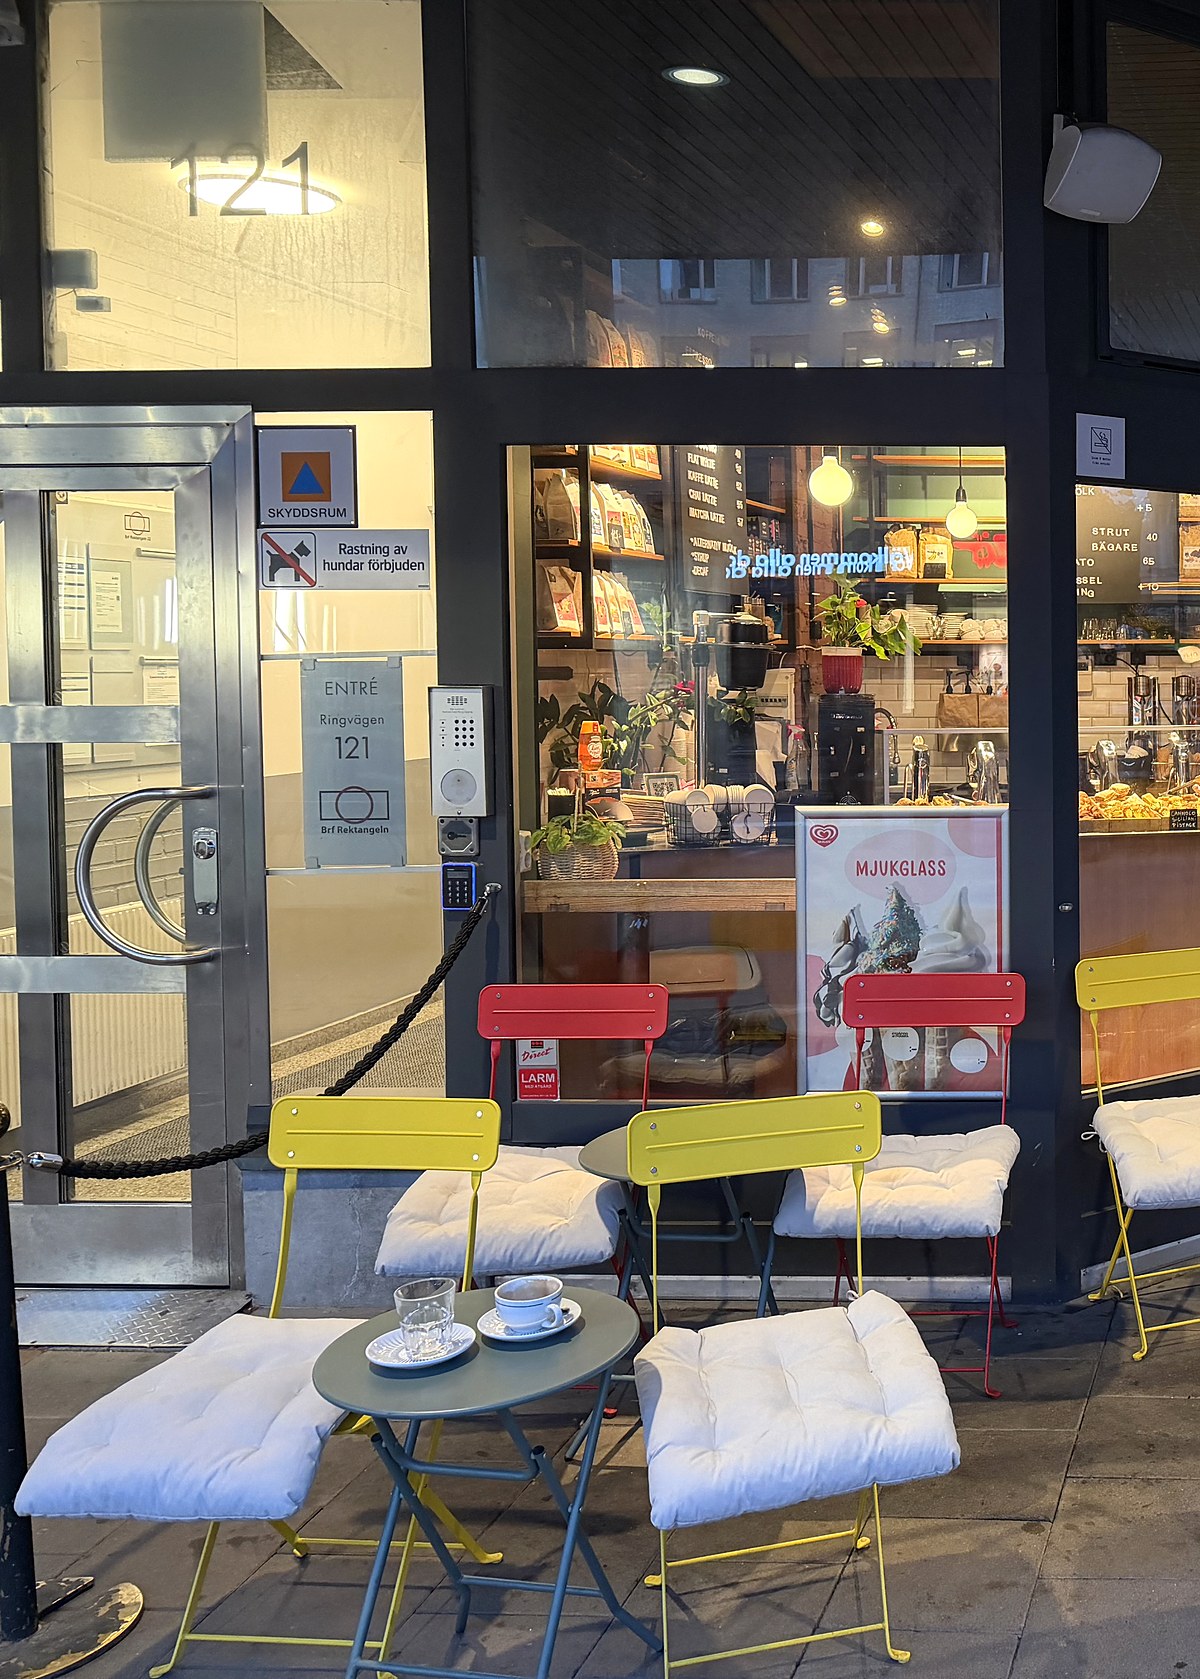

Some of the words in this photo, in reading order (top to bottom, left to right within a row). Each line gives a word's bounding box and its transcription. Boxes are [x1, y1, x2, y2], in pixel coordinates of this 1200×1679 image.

[170, 141, 310, 217] 121
[267, 507, 347, 518] SKYDDSRUM
[1091, 527, 1130, 537] STRUT
[1146, 532, 1158, 541] 40
[338, 542, 390, 557] Rastning
[393, 545, 408, 555] av
[1091, 540, 1138, 552] BÄGARE
[322, 559, 365, 571] hundar
[367, 559, 425, 574] förbjuden
[1142, 556, 1155, 566] 65
[325, 677, 379, 696] ENTRÉ
[319, 714, 385, 728] Ringvägen
[334, 736, 369, 759] 121
[321, 825, 336, 834] Brf
[336, 825, 389, 836] Rektangeln
[856, 859, 946, 877] MJUKGLASS
[521, 1073, 555, 1083] LARM
